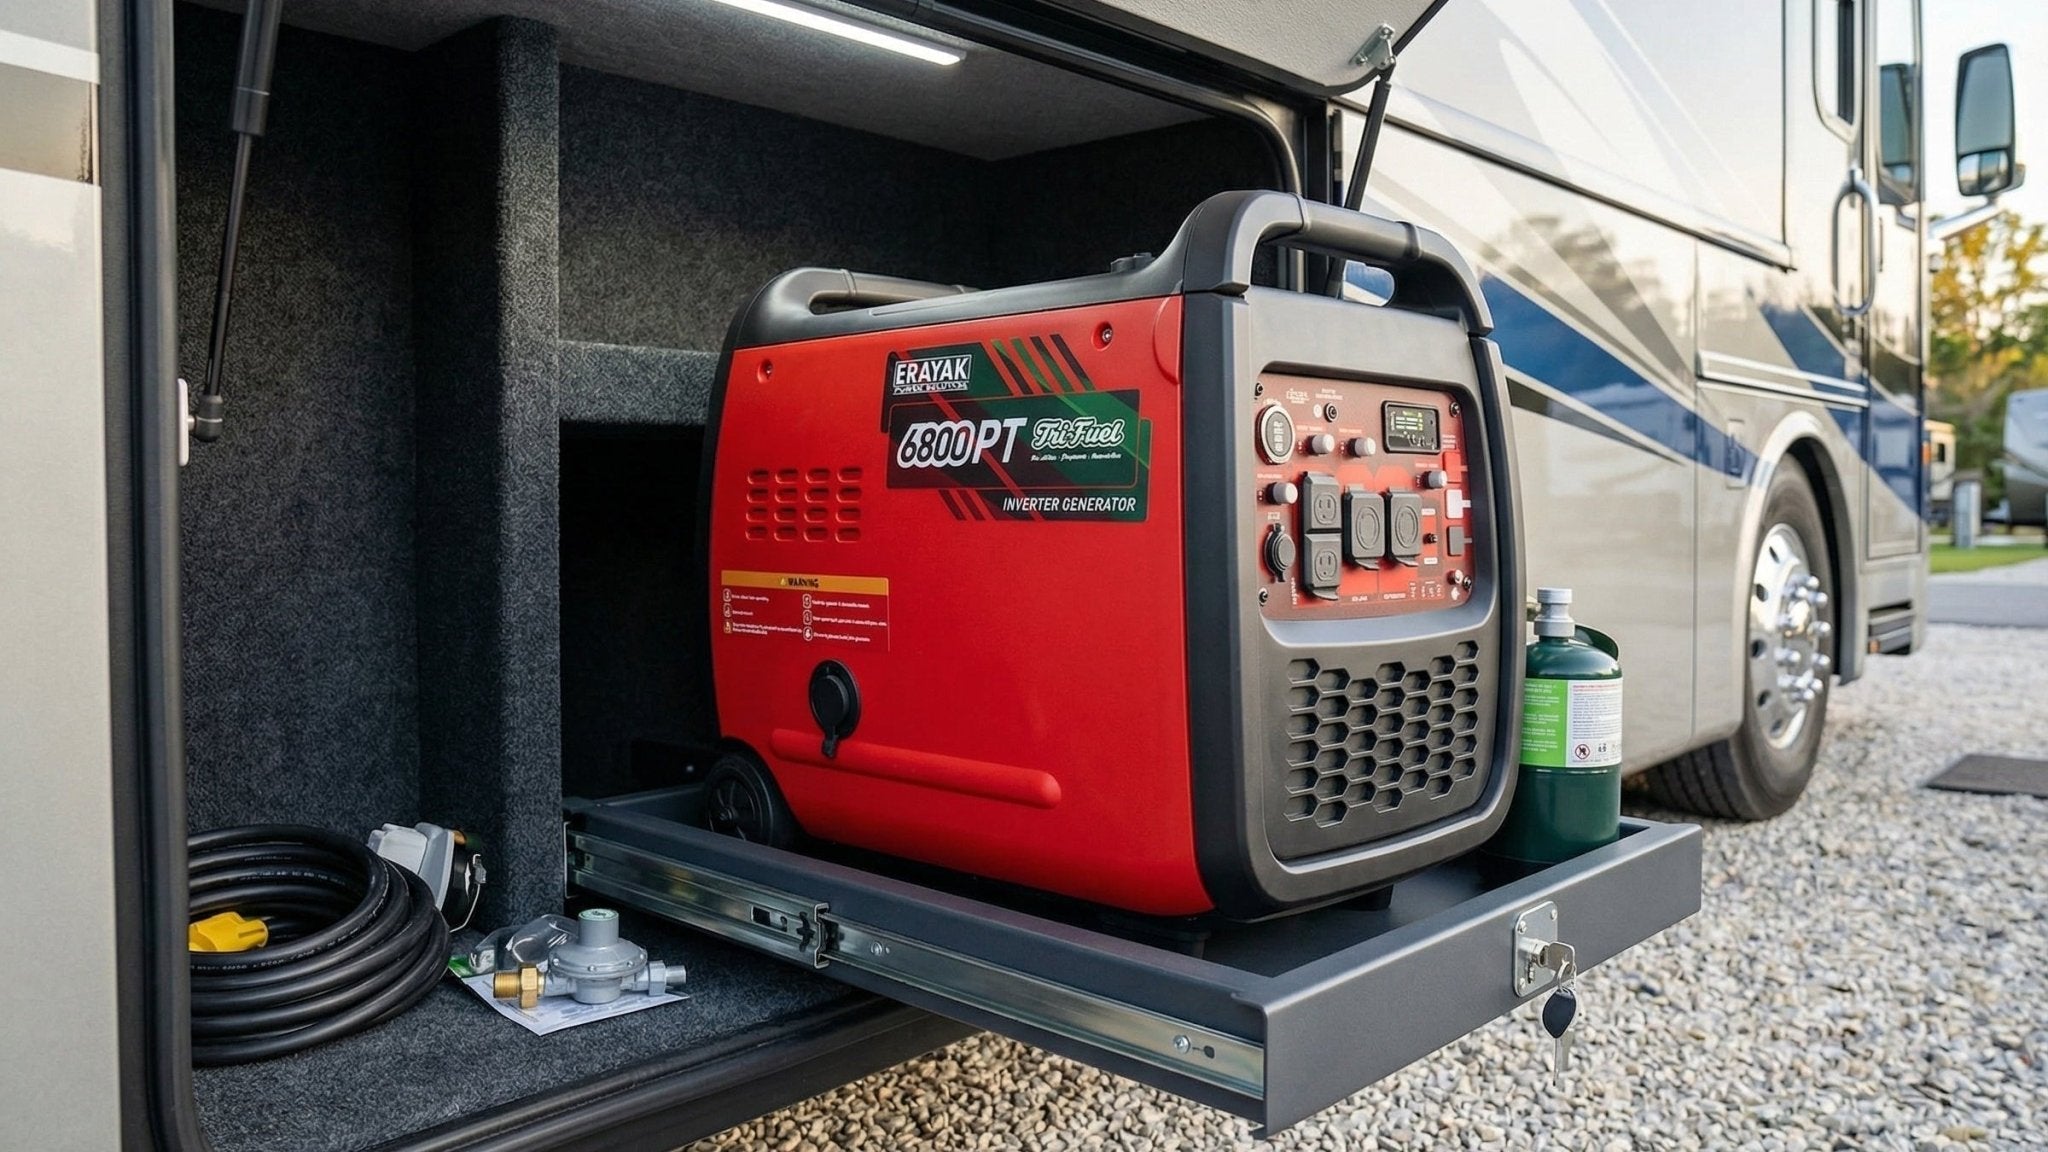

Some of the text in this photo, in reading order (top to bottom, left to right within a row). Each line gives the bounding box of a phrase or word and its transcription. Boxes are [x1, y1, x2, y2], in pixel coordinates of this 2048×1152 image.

[895, 357, 969, 385] ERAYAK
[897, 417, 1028, 468] 6800PT
[1003, 497, 1136, 511] INVERTER GENERATOR
